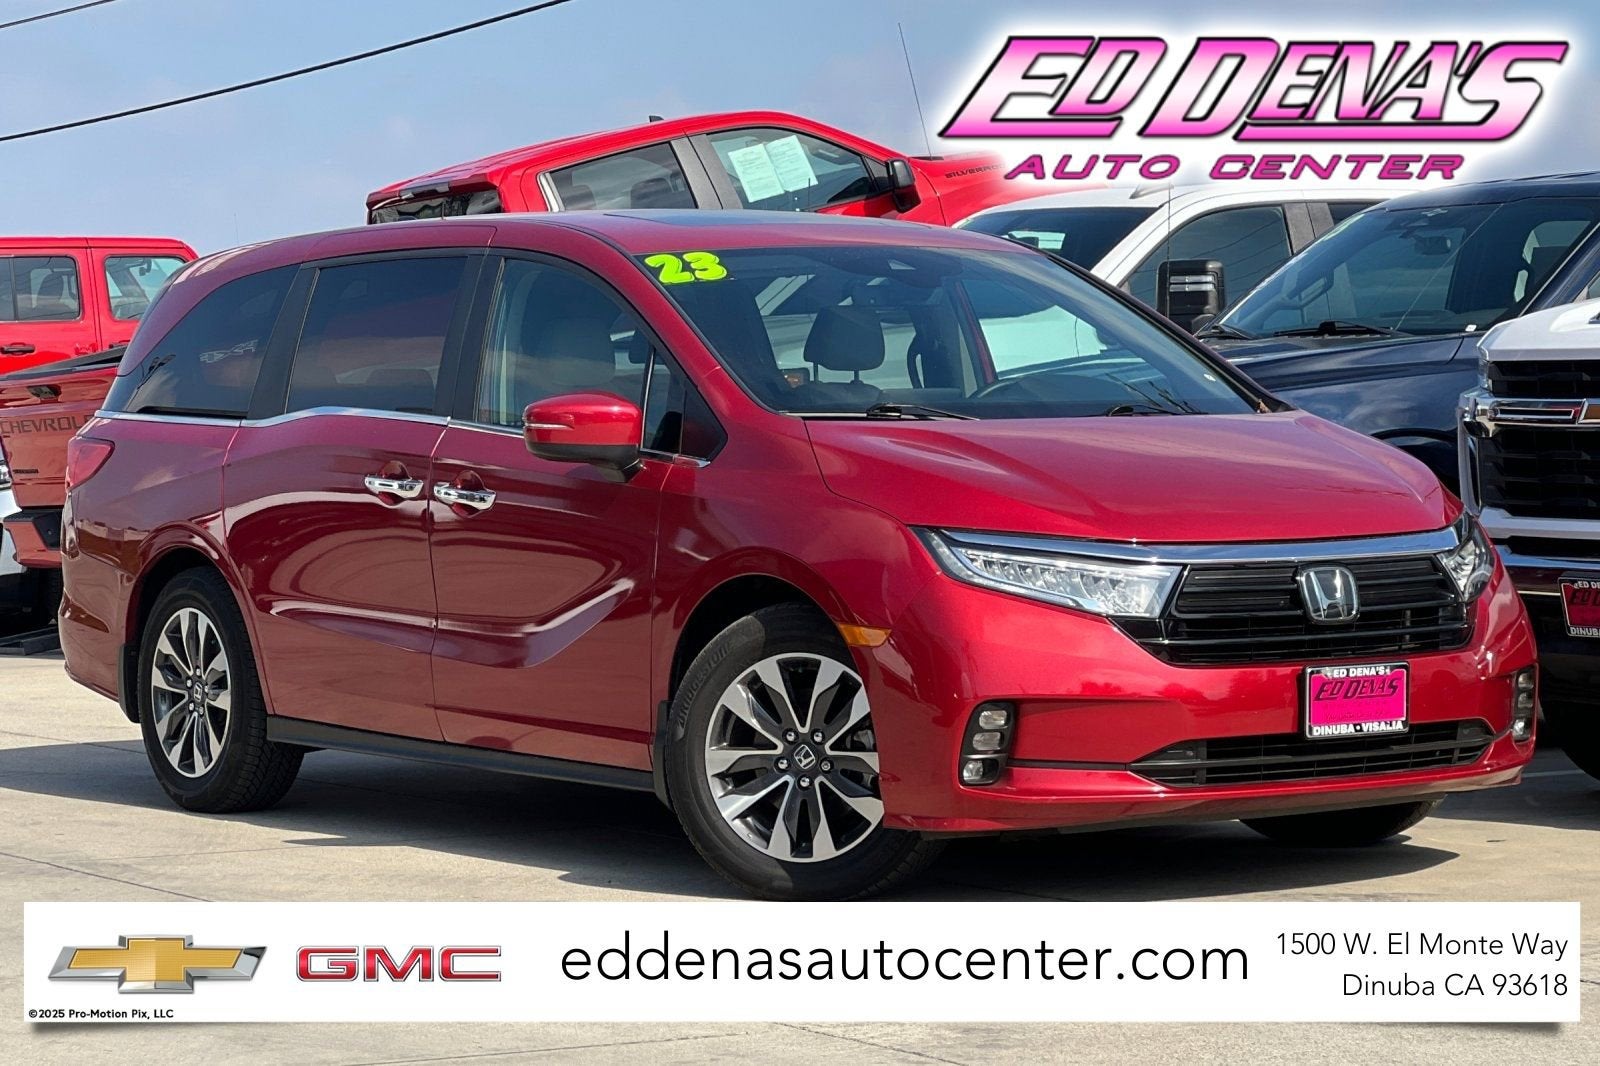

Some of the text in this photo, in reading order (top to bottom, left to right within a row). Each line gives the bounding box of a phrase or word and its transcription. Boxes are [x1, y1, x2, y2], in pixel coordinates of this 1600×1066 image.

[644, 251, 728, 284] 23
[1333, 666, 1385, 678] ED DENA'S
[1315, 681, 1345, 700] ED
[1313, 720, 1404, 736] DINUBA VISALIA
